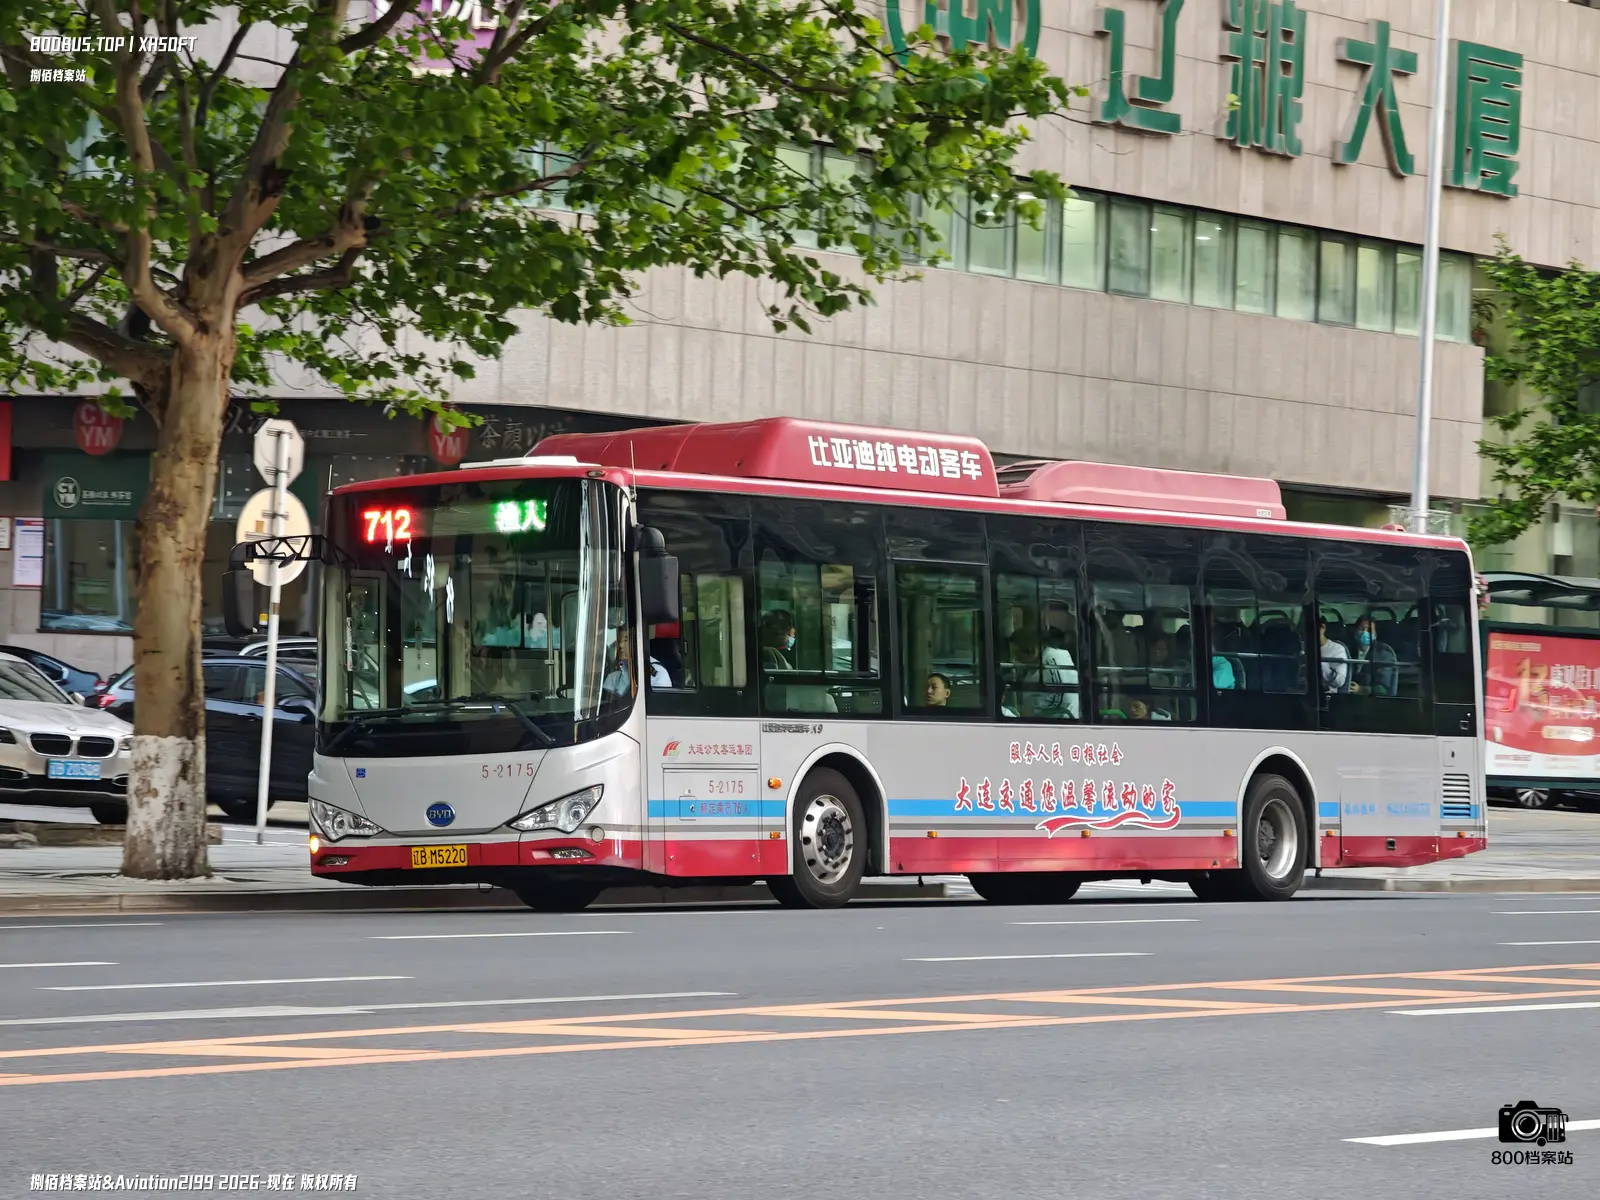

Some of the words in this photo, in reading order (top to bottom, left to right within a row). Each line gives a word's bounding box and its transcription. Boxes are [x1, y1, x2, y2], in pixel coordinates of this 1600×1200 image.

[80, 425, 113, 448] YM
[807, 435, 983, 481] 比亚迪纯电动客车
[363, 509, 412, 542] 712
[688, 743, 753, 756] 大连公交客运集团
[1009, 740, 1064, 767] 服务人民
[481, 762, 535, 779] 5-2175
[708, 780, 744, 794] 5-2175
[954, 776, 1178, 815] 大连交通您温馨流动的家
[429, 809, 452, 820] BYD
